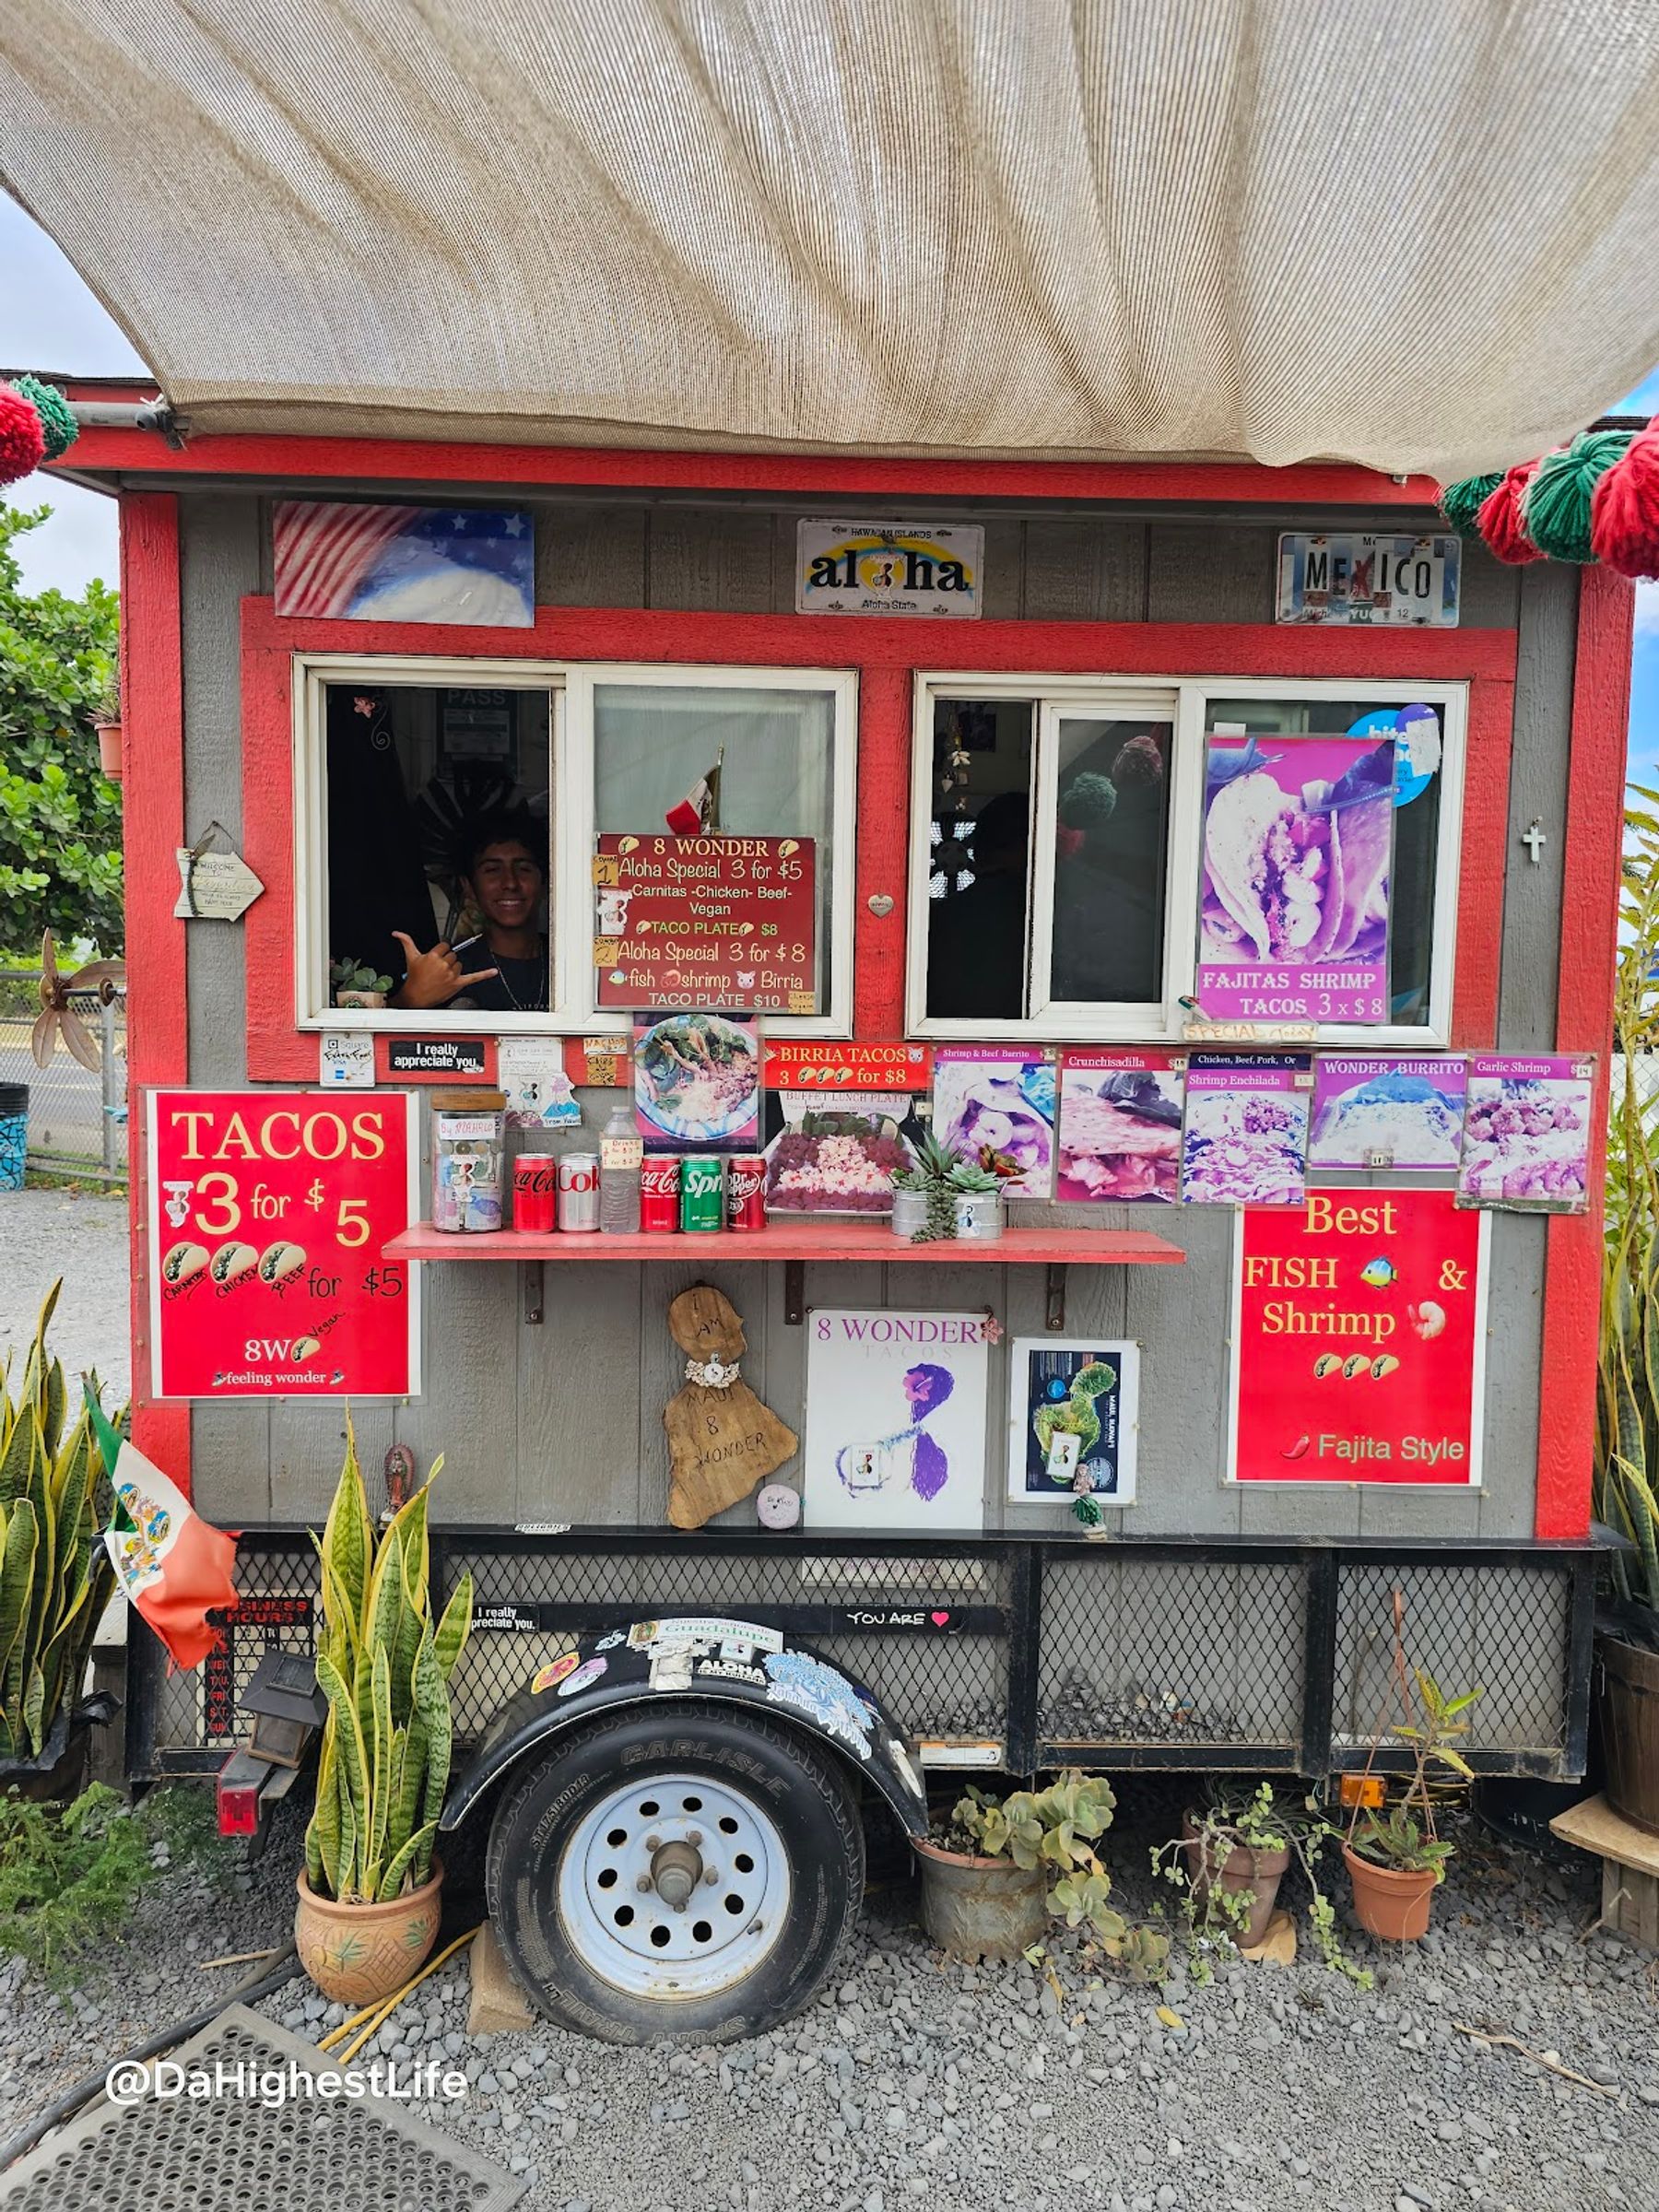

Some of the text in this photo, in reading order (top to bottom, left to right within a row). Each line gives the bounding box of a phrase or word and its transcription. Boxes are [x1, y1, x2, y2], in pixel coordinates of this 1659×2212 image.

[1306, 552, 1430, 598] MEXICO
[891, 600, 917, 610] State
[448, 690, 506, 705] PASS
[653, 838, 770, 857] 8 WONDER
[597, 865, 612, 885] 1
[618, 857, 662, 878] Aloha
[666, 858, 721, 884] Special
[731, 860, 746, 879] 3
[751, 859, 771, 879] for
[777, 860, 803, 880] $5
[689, 902, 731, 917] Vegan
[651, 923, 689, 935] TACO
[694, 923, 738, 935] PLATE
[618, 941, 660, 961] Aloha
[665, 942, 719, 966] Special
[728, 943, 743, 962] 3
[748, 943, 770, 962] for
[628, 969, 804, 993] fish shrimp Birria
[1203, 972, 1376, 989] FAJITAS SHRIMP
[649, 993, 691, 1006] TACO
[696, 994, 745, 1006] PLATE
[753, 994, 781, 1007] $10
[1240, 998, 1307, 1015] TACOS
[1318, 993, 1331, 1015] 3
[417, 1042, 459, 1057] I really
[780, 1047, 907, 1063] BIRRIA TACOS
[943, 1049, 971, 1059] Shrimp
[972, 1050, 980, 1058] &
[982, 1050, 999, 1058] Beef
[394, 1055, 453, 1069] appreciate
[1068, 1056, 1145, 1067] Crunchisadilla
[1198, 1055, 1296, 1065] Chicken, Beef, Pork, Or
[1324, 1061, 1465, 1075] WONDER BURRITO
[1477, 1062, 1509, 1072] Garlic
[1511, 1062, 1551, 1076] Shrimp
[780, 1067, 906, 1085] 3 for $8
[1189, 1075, 1280, 1087] Shrimp Enchilada
[831, 1092, 866, 1102] LUNCH
[171, 1112, 385, 1160] TACOS
[195, 1172, 241, 1235] 3
[250, 1183, 291, 1219] for
[1302, 1196, 1397, 1235] Best
[216, 1264, 260, 1299] CHICKEN
[271, 1264, 306, 1299] BEEF
[307, 1266, 403, 1298] for $5
[1244, 1256, 1467, 1290] FISH &
[307, 1312, 347, 1339] Vegan
[818, 1317, 979, 1344] 8 WONDER
[1262, 1300, 1396, 1344] Shrimp
[244, 1338, 292, 1362] 8W
[863, 1344, 952, 1359] TACOS
[226, 1370, 326, 1386] feeling wonder
[687, 1386, 735, 1407] MAUI
[706, 1415, 719, 1435] 8
[695, 1431, 767, 1468] WONDER
[1318, 1433, 1465, 1465] Fajita Style
[240, 1600, 308, 1612] SINESS
[478, 1606, 517, 1619] I really
[227, 1613, 294, 1623] HOURS
[471, 1617, 536, 1631] preciate you.
[846, 1611, 926, 1625] YOU ARE
[665, 1623, 774, 1643] Guadalupe
[699, 1659, 766, 1678] ALOHA
[209, 1707, 229, 1717] ST.
[620, 1739, 794, 1798] CARLISLE
[557, 1988, 637, 2044] TRAIL
